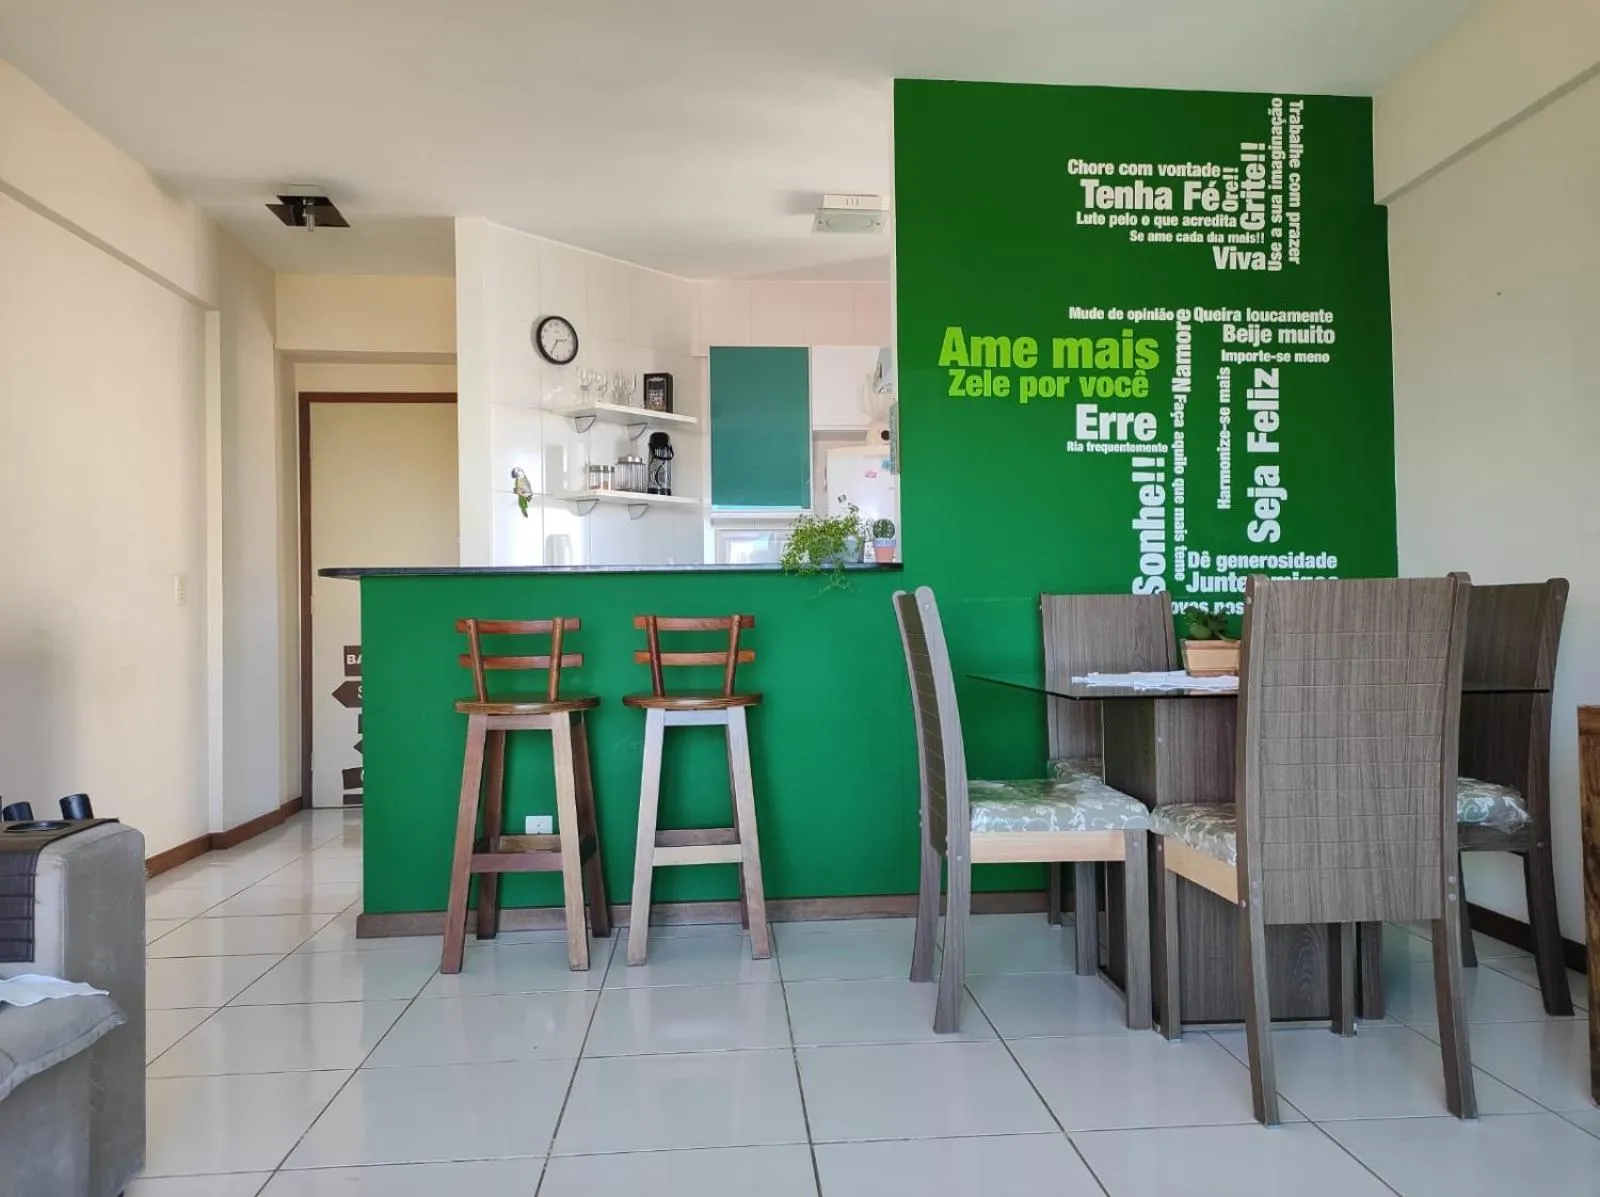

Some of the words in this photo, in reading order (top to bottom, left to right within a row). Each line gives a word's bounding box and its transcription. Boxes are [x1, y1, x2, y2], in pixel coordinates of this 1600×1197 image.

[1267, 97, 1287, 190] imaginação
[1288, 99, 1304, 169] Trabalhe
[1067, 158, 1115, 176] Chore
[1118, 163, 1153, 176] com
[1157, 161, 1221, 178] vontade
[1079, 178, 1173, 211] Tenha
[1183, 180, 1220, 212] Fé
[1221, 167, 1239, 213] Ore!!
[1239, 142, 1266, 231] Grite!!
[1288, 172, 1301, 208] com
[1076, 211, 1106, 226] Lute
[1108, 212, 1138, 229] pelo
[1141, 215, 1151, 226] o
[1153, 215, 1179, 229] que
[1181, 213, 1237, 228] acredita
[1271, 194, 1283, 224] sua
[1129, 229, 1145, 242] Se
[1147, 232, 1173, 243] ame
[1175, 230, 1204, 243] cada
[1206, 231, 1225, 243] dia
[1228, 232, 1264, 244] mais!!
[1270, 227, 1283, 238] a
[1285, 211, 1301, 265] prazer
[1212, 245, 1266, 271] Viva
[1267, 241, 1283, 272] Use
[1068, 306, 1105, 320] Mude
[1107, 307, 1124, 321] de
[1126, 307, 1175, 323] opinião
[1194, 307, 1241, 322] Queira
[1247, 308, 1333, 322] loucamente
[939, 326, 1037, 368] Ame
[1053, 329, 1159, 369] mais
[1172, 309, 1191, 392] Namore
[1222, 323, 1273, 348] Beije
[1278, 325, 1336, 344] muito
[1220, 348, 1292, 365] Importe-se
[948, 368, 1011, 397] Zele
[1019, 375, 1070, 404] por
[1079, 369, 1149, 398] você
[1216, 366, 1231, 404] mais
[1076, 404, 1156, 441] Erre
[1169, 393, 1187, 428] Faça
[1246, 367, 1280, 453] Feliz
[1066, 440, 1085, 452] Ria
[1086, 440, 1169, 455] frequentemente
[1171, 430, 1188, 475] aquilo
[1216, 406, 1231, 510] Harmonize-se
[1171, 477, 1185, 505] que
[1246, 465, 1288, 543] Seja
[1132, 457, 1166, 594] Sonhe!!
[1173, 507, 1188, 542] mais
[1174, 545, 1187, 580] teme
[1187, 550, 1212, 569] Dê
[1216, 552, 1337, 572] generosidade
[1186, 571, 1246, 592] Junte
